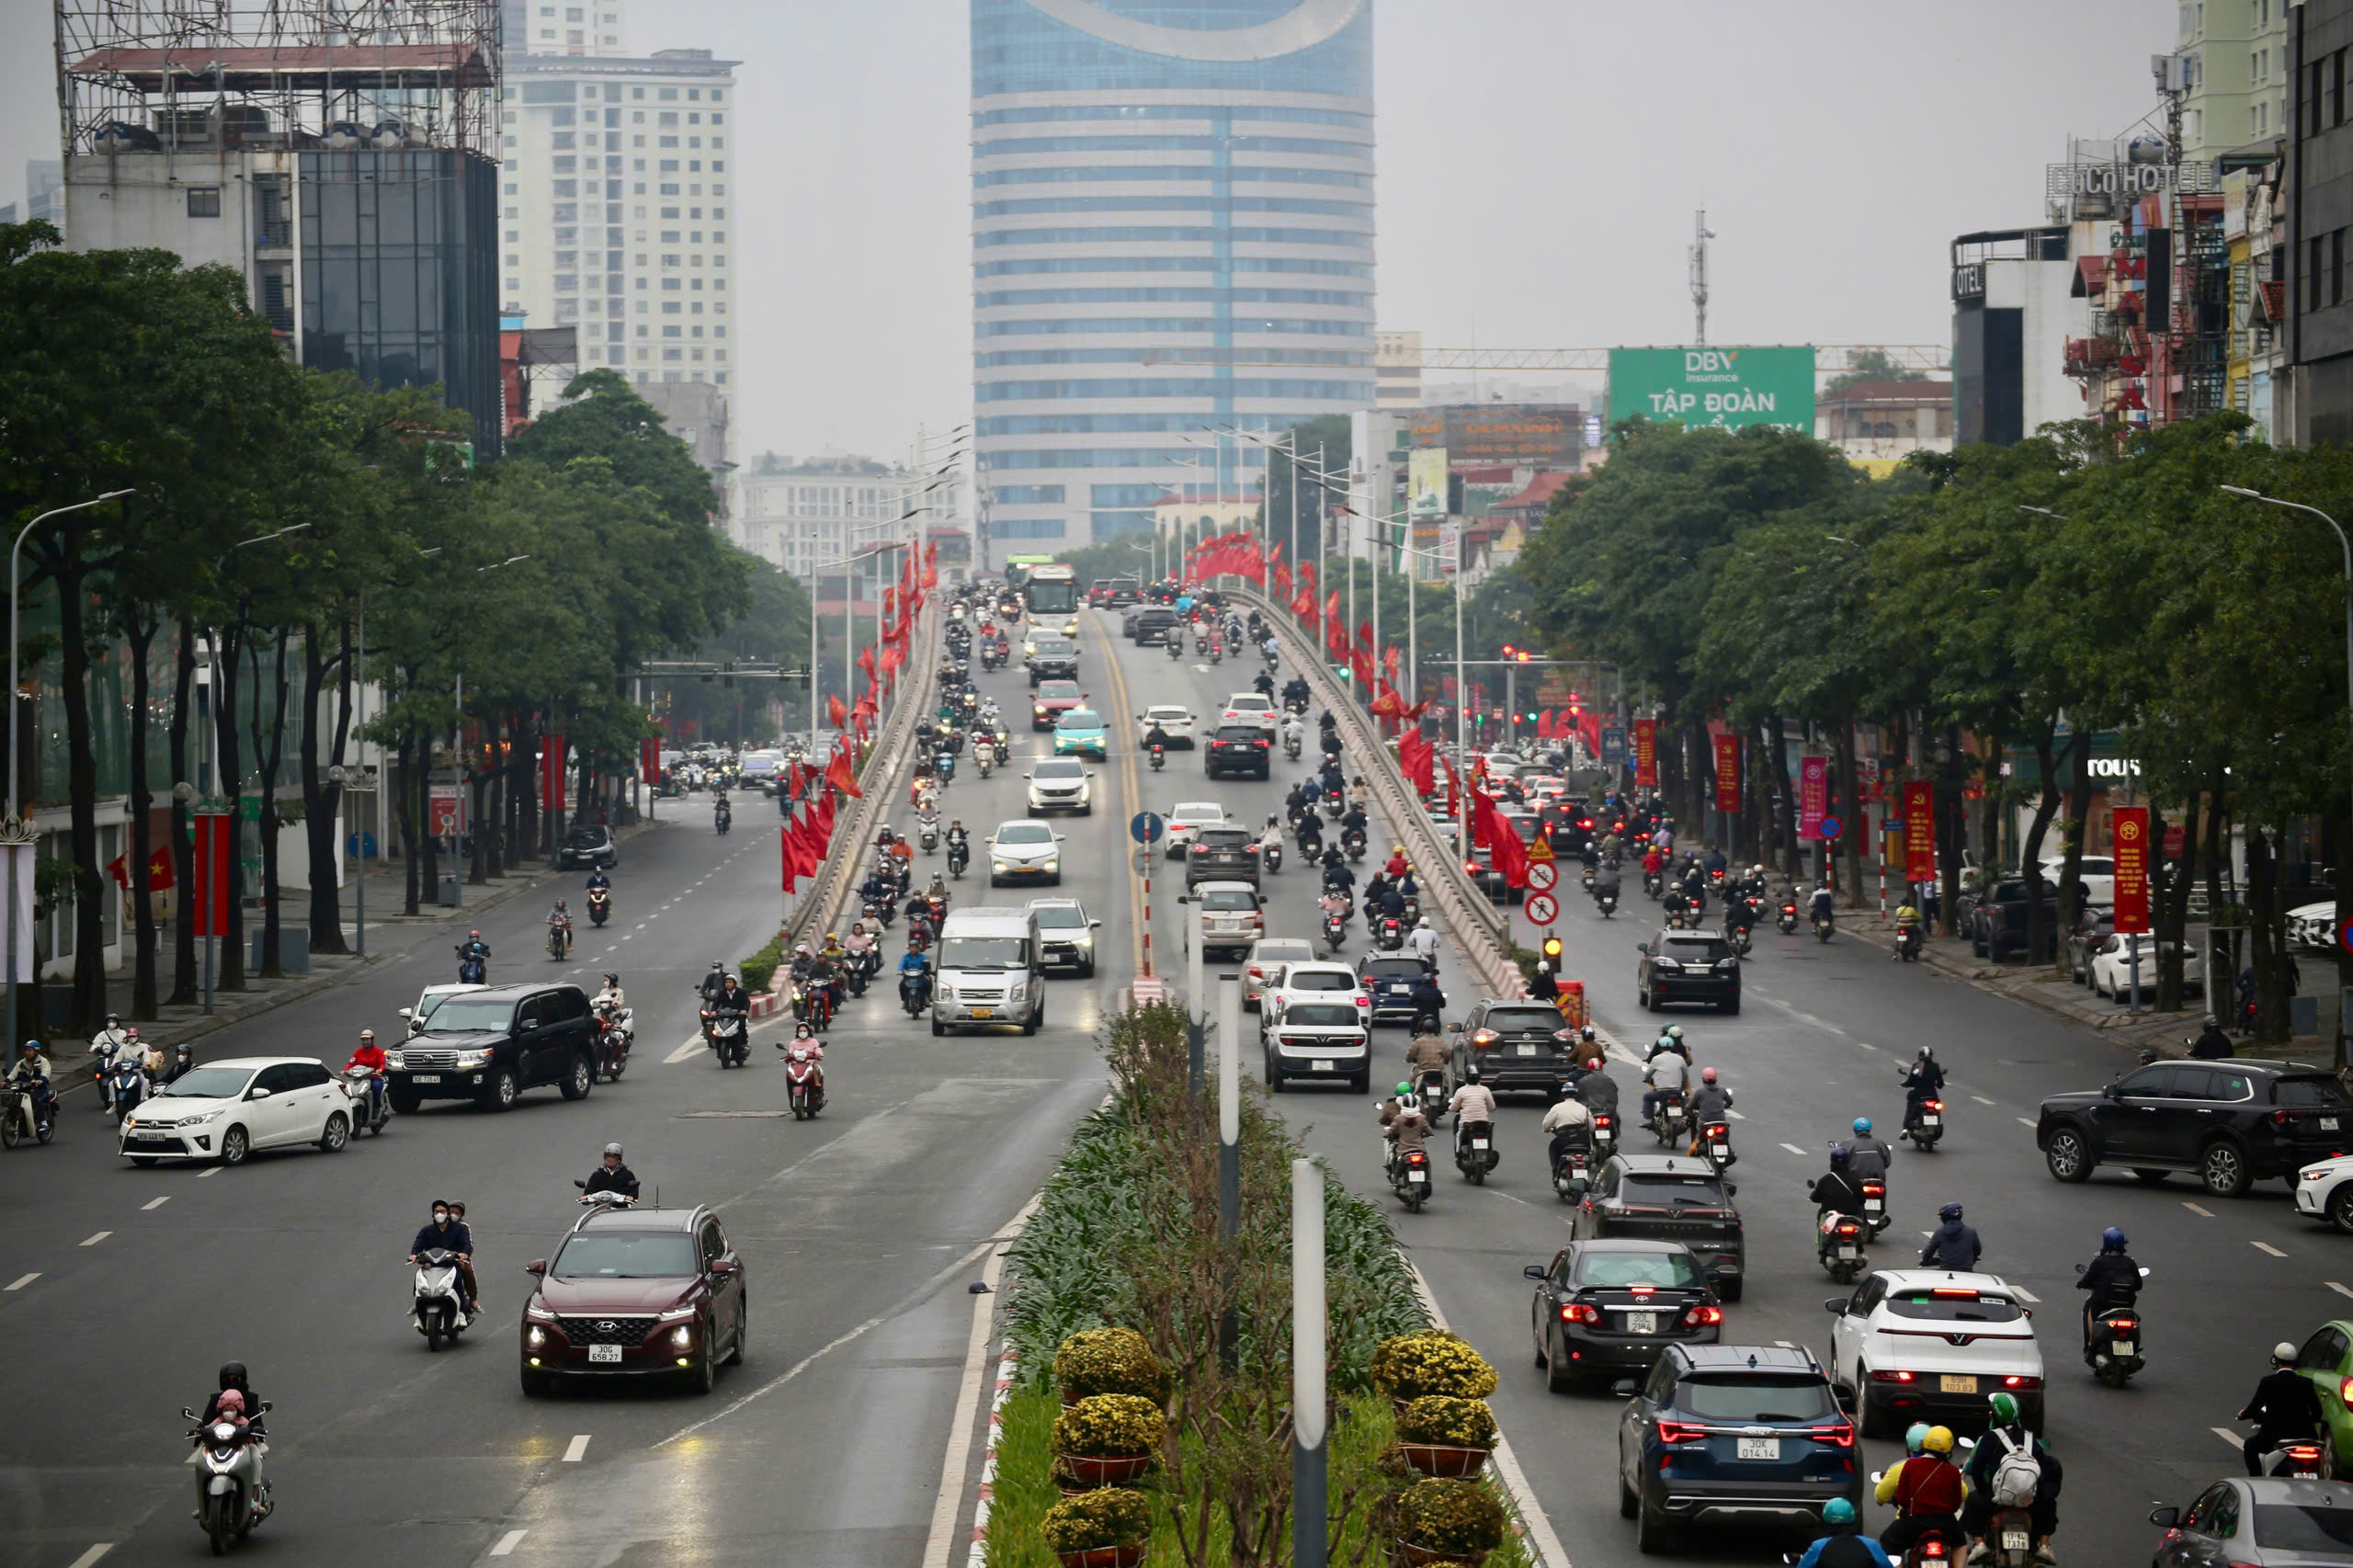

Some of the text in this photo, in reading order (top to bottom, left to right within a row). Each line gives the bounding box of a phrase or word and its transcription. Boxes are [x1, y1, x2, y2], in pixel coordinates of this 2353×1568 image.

[2122, 165, 2212, 193] HOTEL
[1685, 351, 1738, 371] DBV
[1648, 387, 1775, 418] TẬP ĐOÀN
[592, 1353, 619, 1361] 658.27
[1749, 1439, 1767, 1449] 30K
[1742, 1449, 1774, 1458] 014.14
